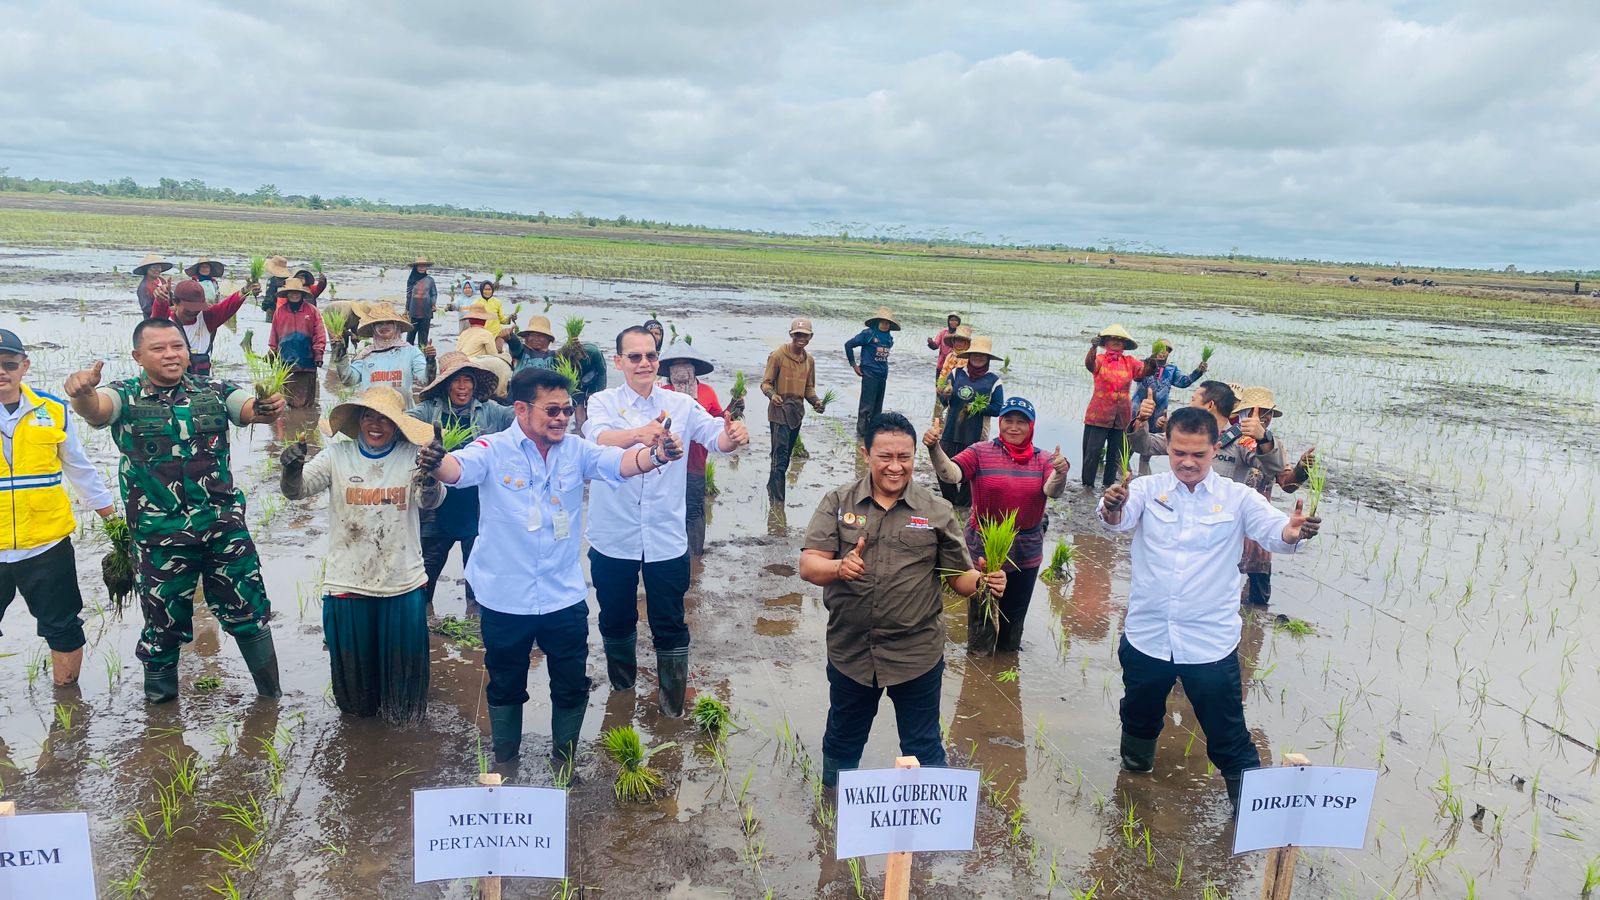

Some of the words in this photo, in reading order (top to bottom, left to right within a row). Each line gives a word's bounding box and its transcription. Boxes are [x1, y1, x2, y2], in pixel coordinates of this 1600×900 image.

[845, 785, 889, 805] WAKIL
[892, 784, 968, 803] GUBERNUR
[1251, 794, 1317, 812] DIRJEN
[1322, 795, 1357, 809] PSP
[449, 812, 533, 827] MENTERI
[870, 807, 942, 828] KALTENG
[429, 835, 529, 852] PERTANIAN
[534, 836, 550, 849] RI
